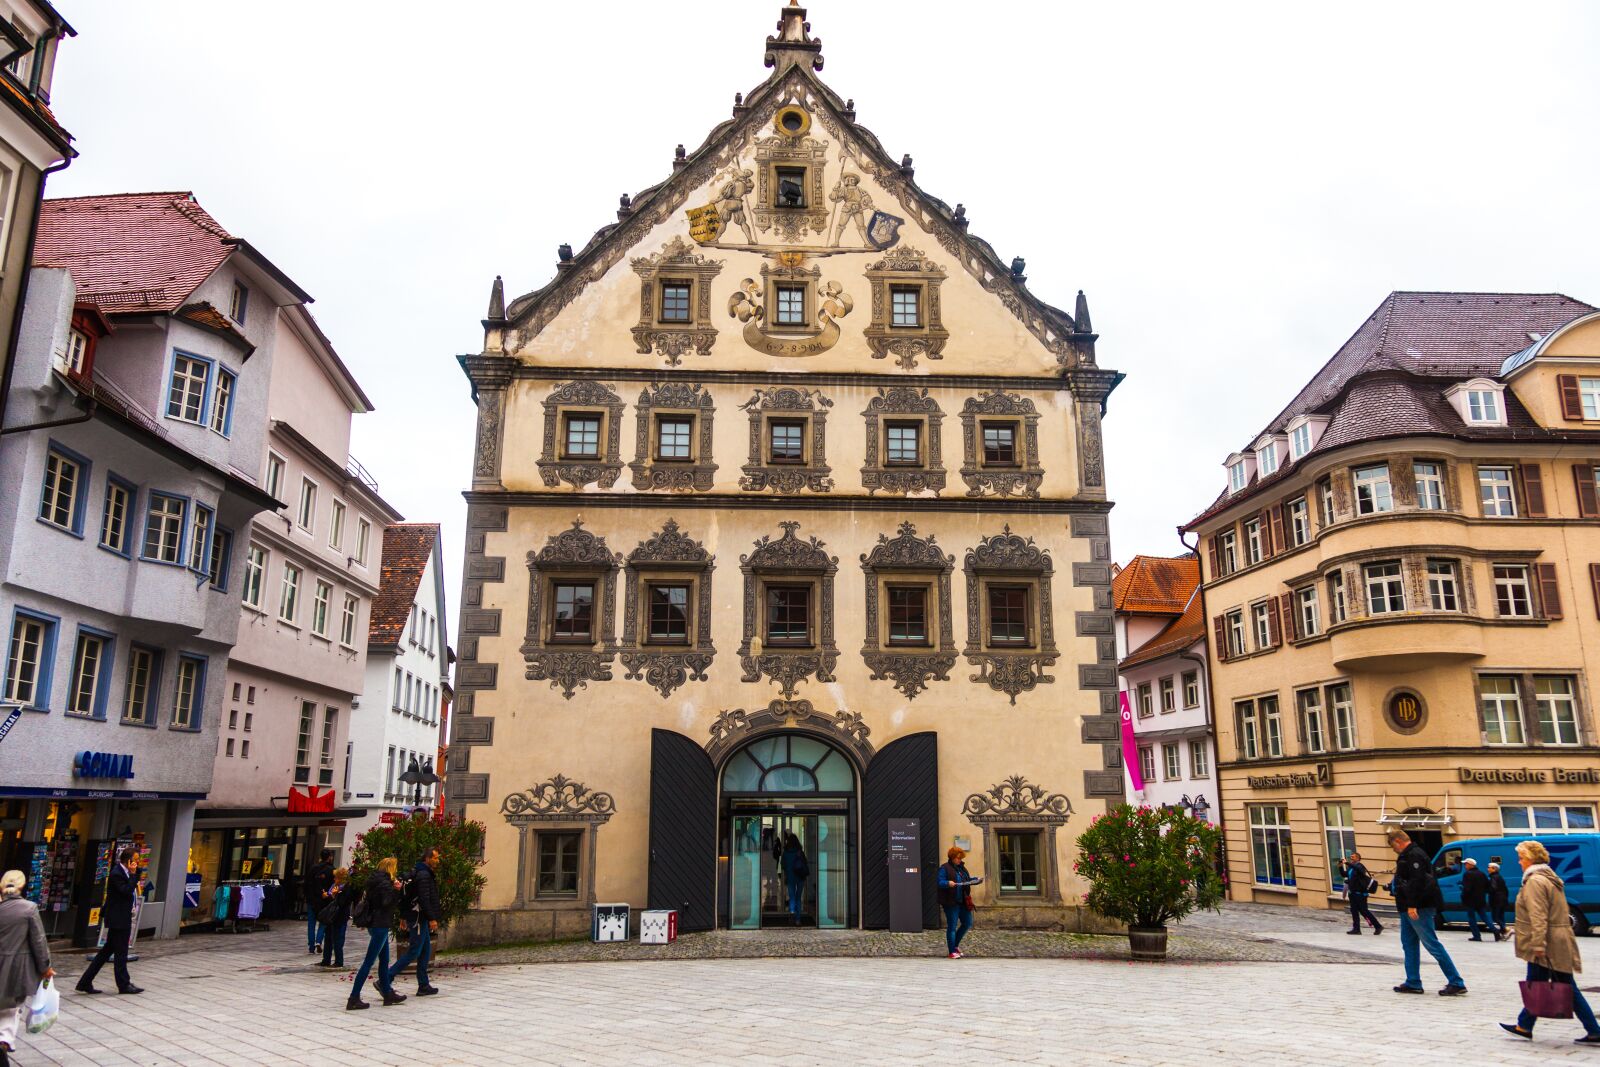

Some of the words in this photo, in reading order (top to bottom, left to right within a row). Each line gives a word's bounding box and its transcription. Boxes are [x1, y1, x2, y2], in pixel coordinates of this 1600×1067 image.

[79, 750, 135, 779] SCHAAL
[1248, 774, 1286, 787] Deutsche
[1289, 772, 1313, 786] Bank
[1459, 766, 1547, 783] Deutsche
